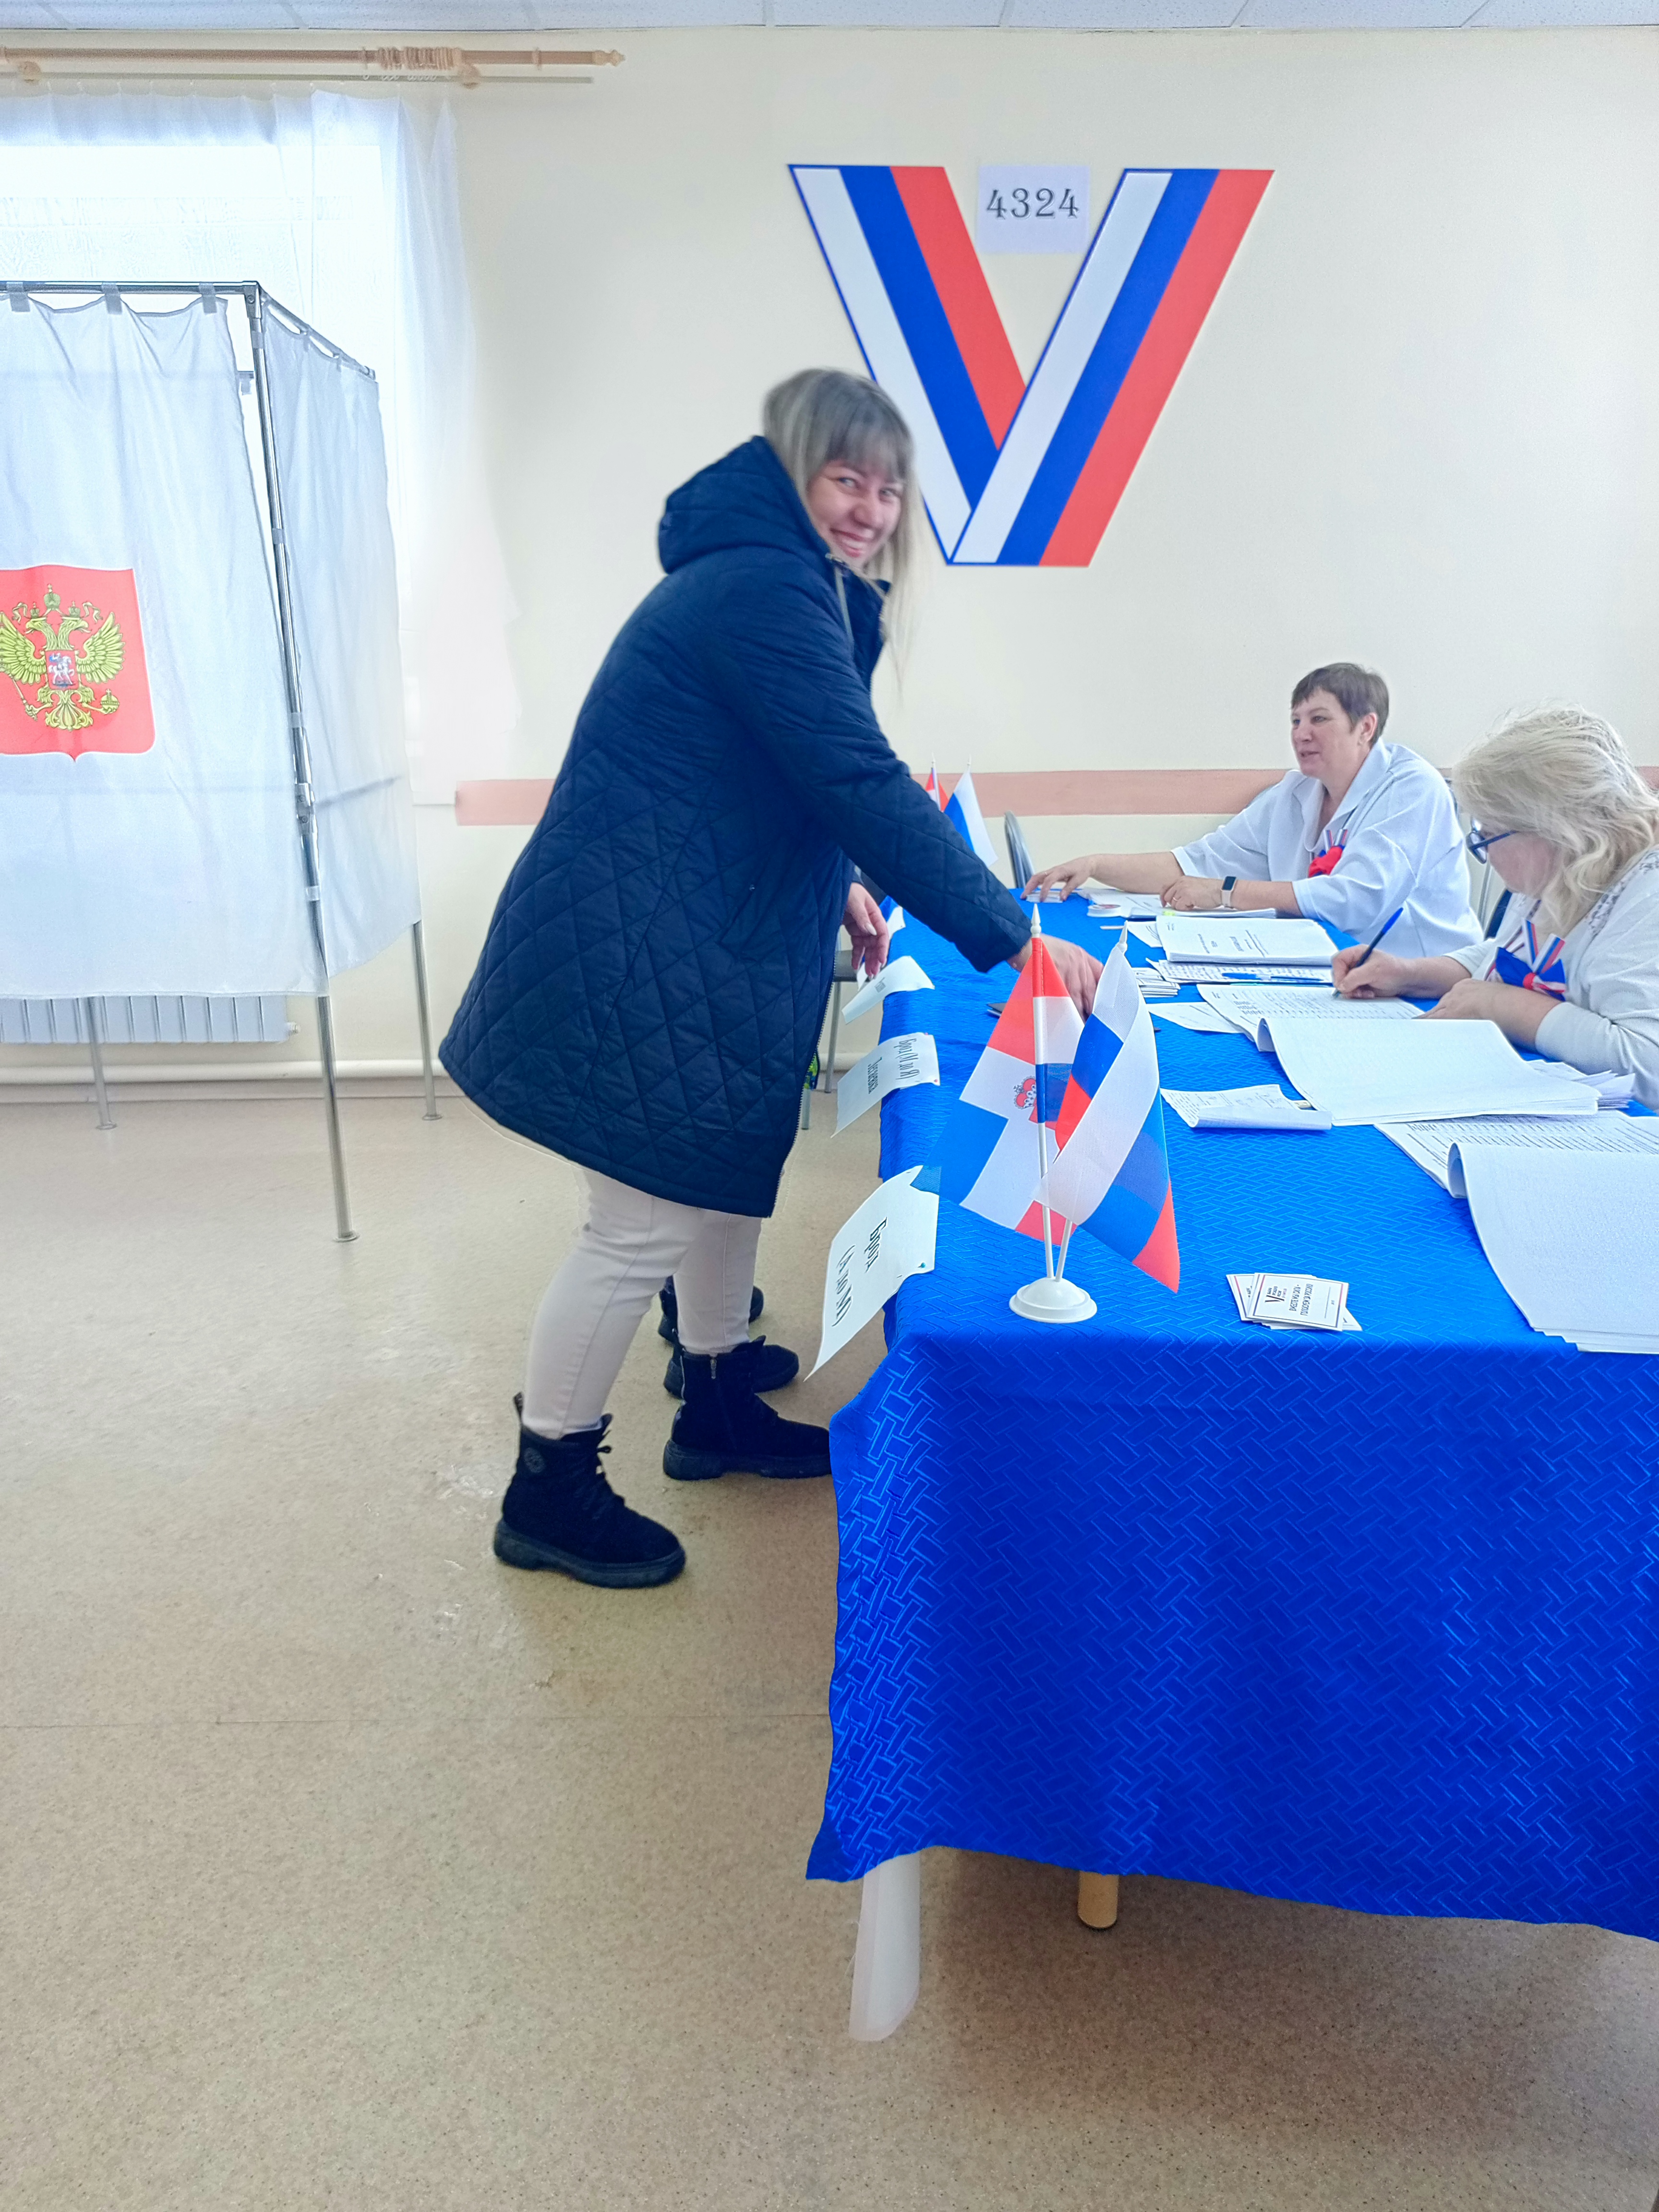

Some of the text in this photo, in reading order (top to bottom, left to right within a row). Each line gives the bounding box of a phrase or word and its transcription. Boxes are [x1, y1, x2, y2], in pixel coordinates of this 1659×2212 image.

[986, 188, 1079, 219] 4324
[894, 1038, 917, 1054] Брод
[864, 1216, 888, 1273] Брод
[831, 1245, 855, 1327] (А до М)
